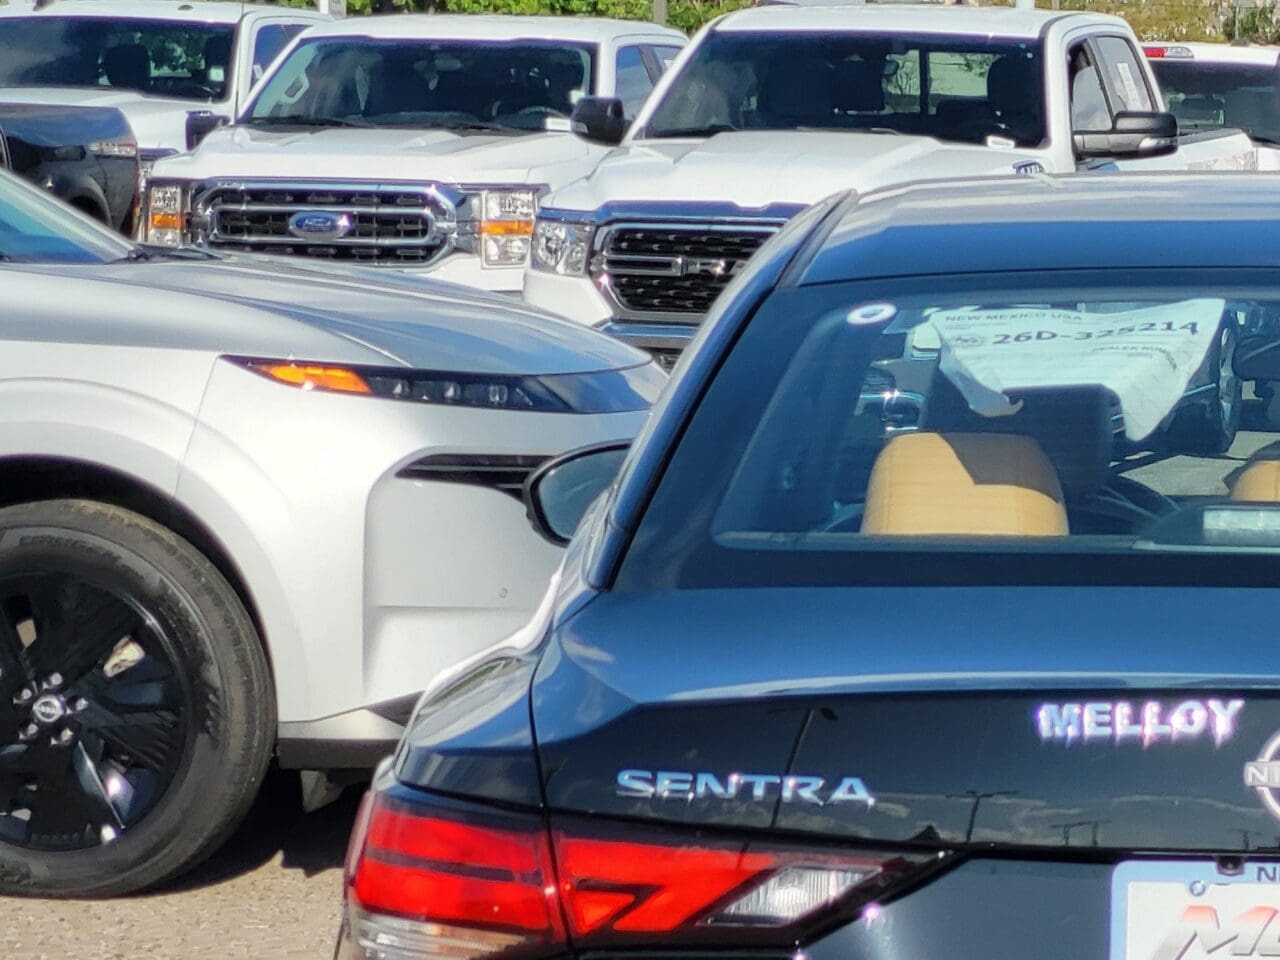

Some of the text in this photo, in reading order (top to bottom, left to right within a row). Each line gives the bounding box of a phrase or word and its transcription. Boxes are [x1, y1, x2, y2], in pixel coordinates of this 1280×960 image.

[992, 320, 1199, 344] 26D-325214
[1038, 700, 1244, 742] MELLOY
[615, 769, 876, 806] SENTRA
